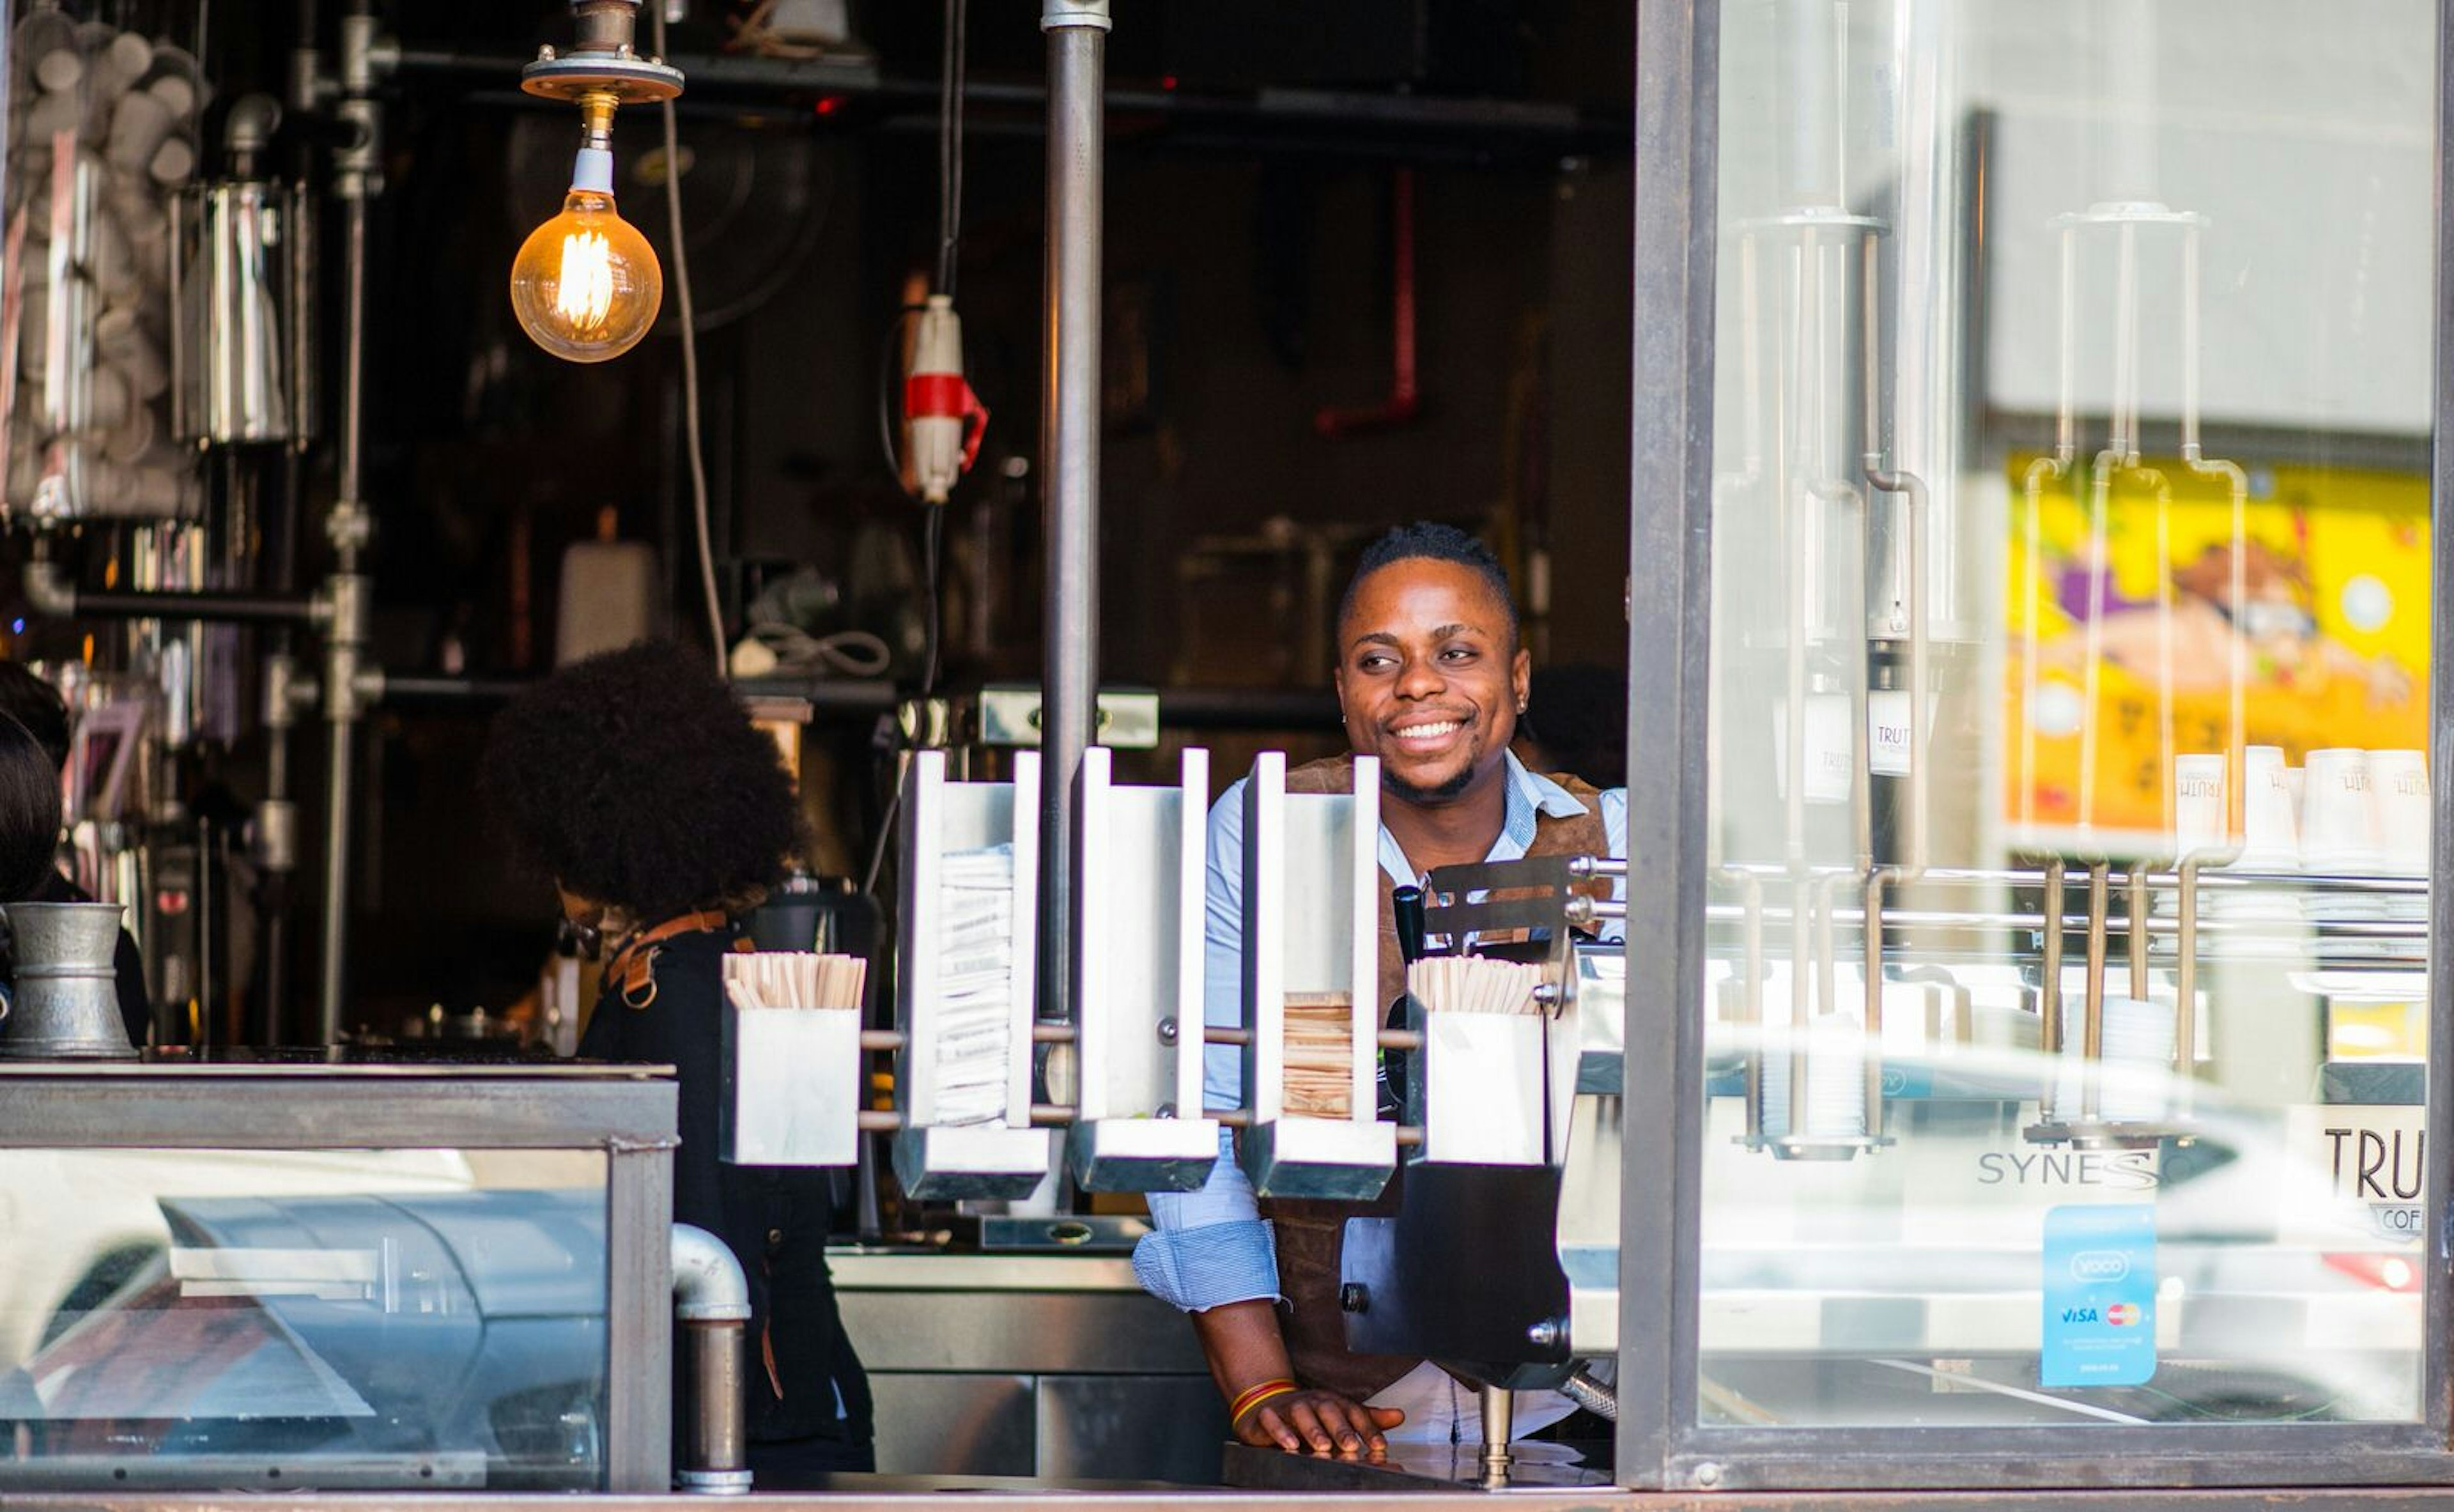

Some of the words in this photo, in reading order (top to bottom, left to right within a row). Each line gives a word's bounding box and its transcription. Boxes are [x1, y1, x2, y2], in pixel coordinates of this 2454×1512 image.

[2325, 1129, 2424, 1199] TRU
[2383, 1210, 2421, 1229] COF
[2062, 1309, 2099, 1323] VISA
